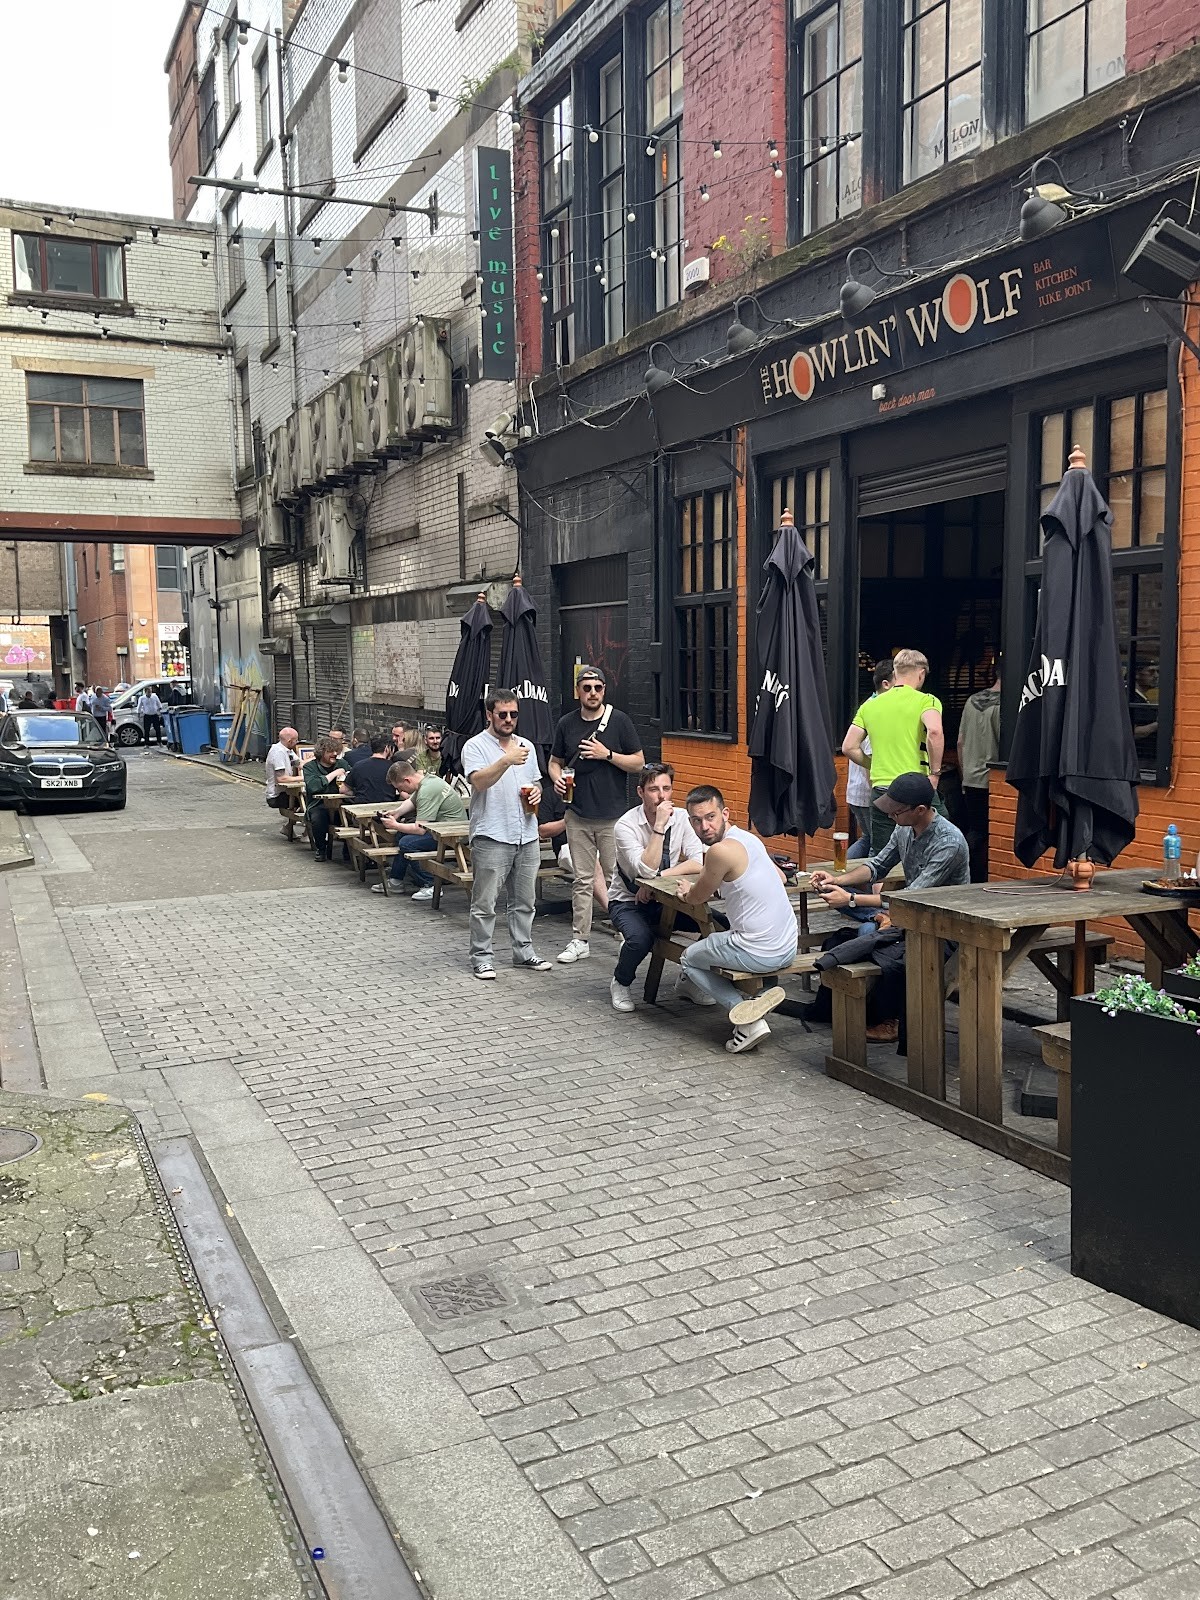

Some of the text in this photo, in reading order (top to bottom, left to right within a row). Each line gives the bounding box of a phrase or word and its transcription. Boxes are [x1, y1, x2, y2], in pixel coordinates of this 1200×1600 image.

[1033, 258, 1052, 274] BAR
[1035, 265, 1078, 291] KITCHEN
[905, 267, 1023, 347] WOLF
[1038, 278, 1092, 308] JUKE JOINT
[759, 365, 773, 405] THE
[879, 387, 936, 413] back door man
